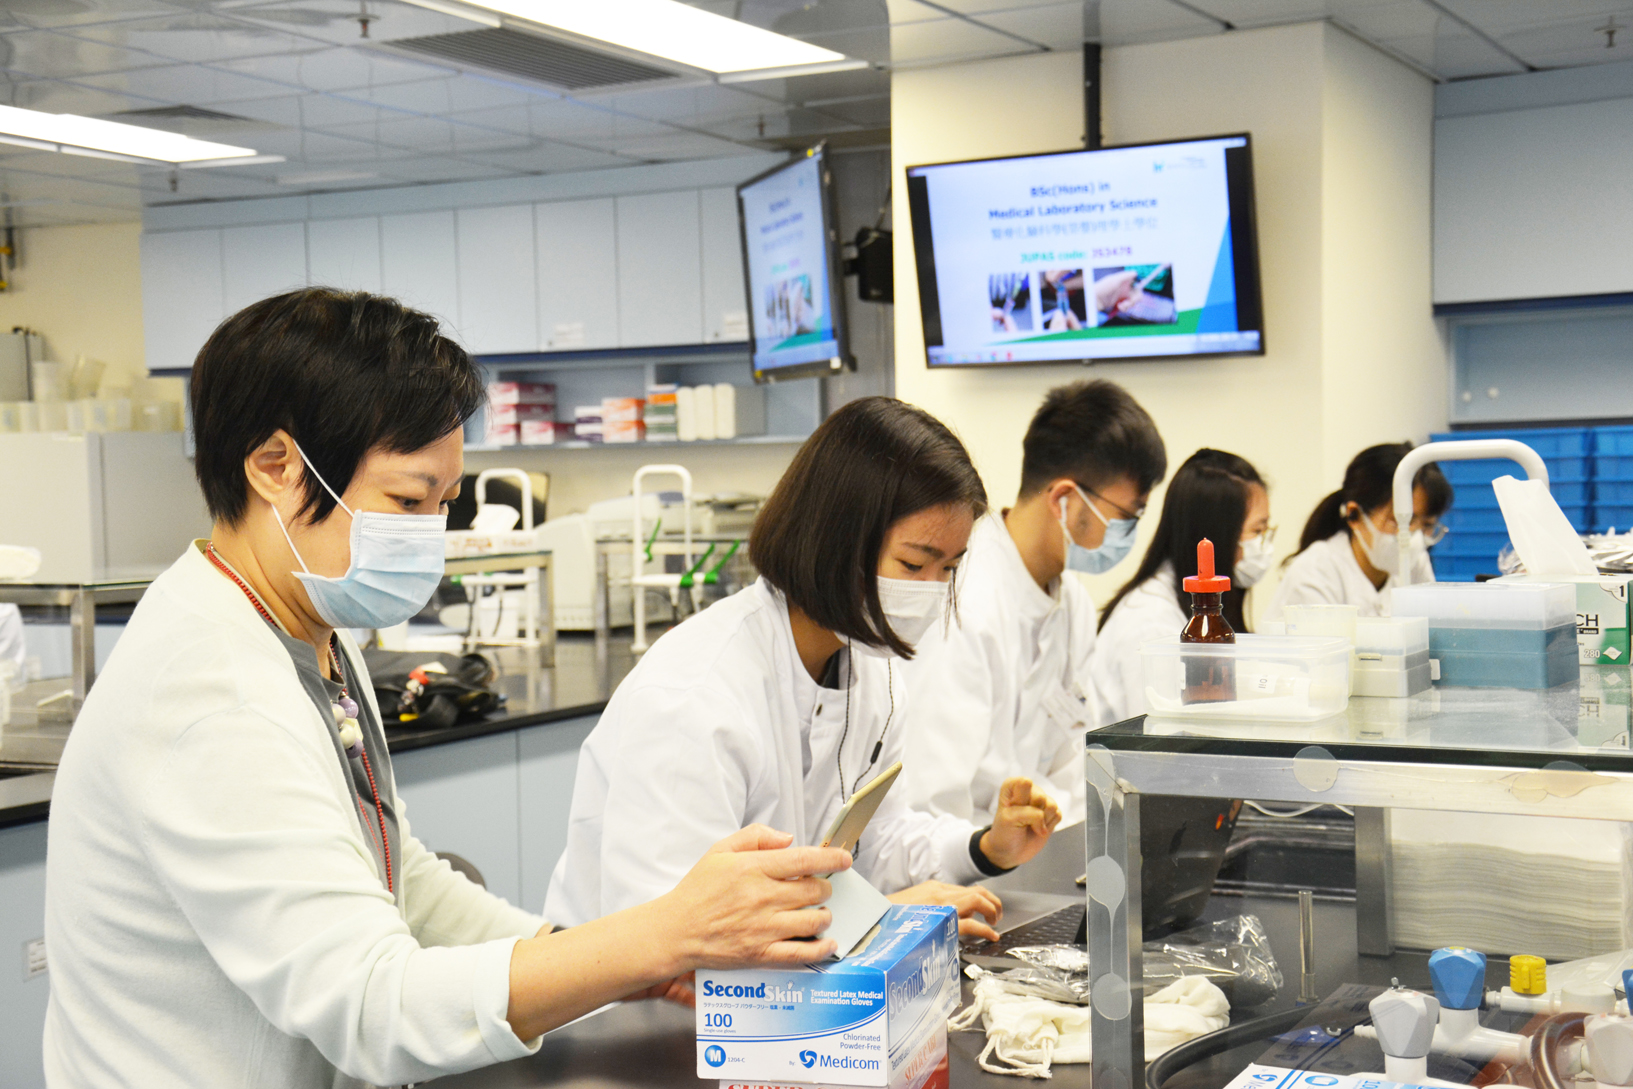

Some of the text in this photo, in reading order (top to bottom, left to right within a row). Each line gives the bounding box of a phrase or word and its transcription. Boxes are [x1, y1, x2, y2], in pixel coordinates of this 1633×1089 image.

[1030, 182, 1111, 198] BSc(Hons) in
[989, 198, 1158, 220] Medical Laboratory Science
[1020, 251, 1055, 264] JUPAS
[1619, 585, 1624, 597] 1
[1584, 649, 1600, 658] 280
[888, 942, 941, 1021] SecondSkin
[703, 980, 803, 1003] SecondSkin
[810, 989, 883, 1000] Textured Latex Medical
[810, 997, 873, 1006] Examination Gloves
[704, 1013, 733, 1027] 100
[843, 1033, 881, 1042] Chlorinated
[840, 1042, 881, 1051] Powder-Free
[709, 1049, 721, 1062] M
[820, 1054, 880, 1070] Medicom
